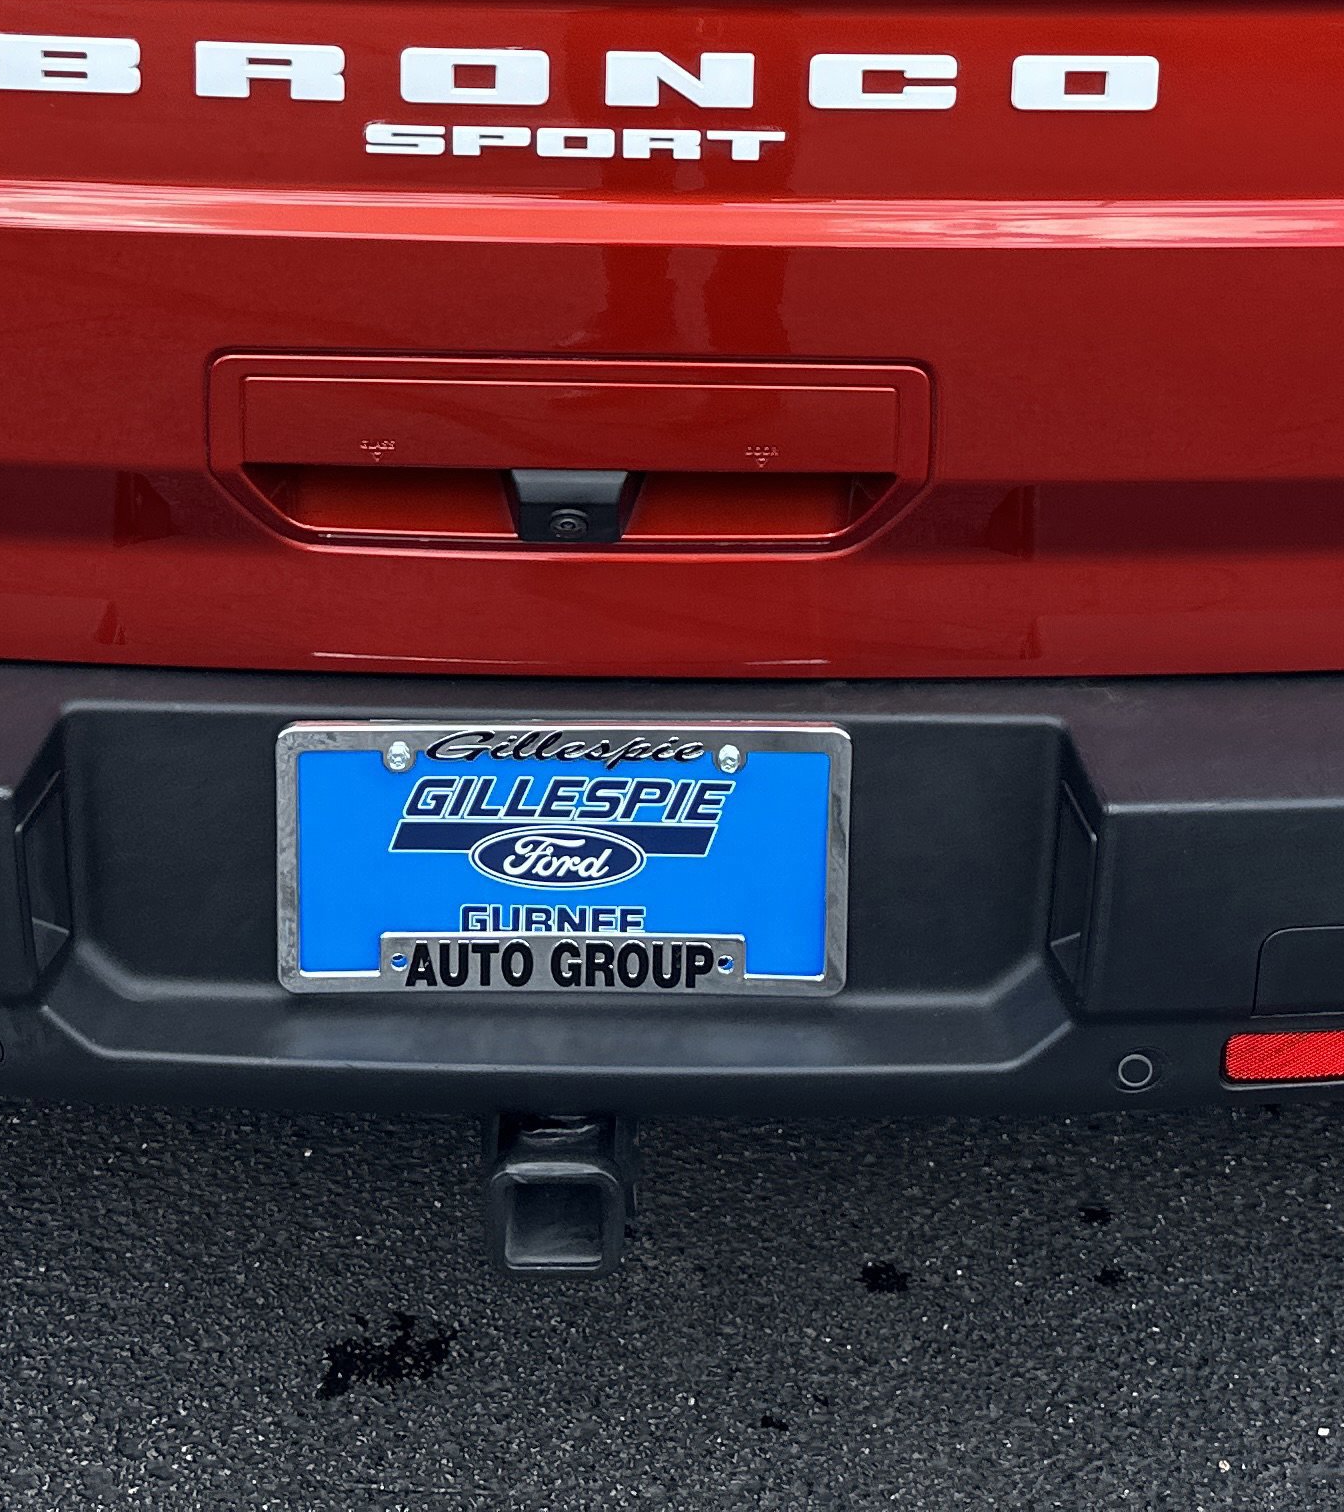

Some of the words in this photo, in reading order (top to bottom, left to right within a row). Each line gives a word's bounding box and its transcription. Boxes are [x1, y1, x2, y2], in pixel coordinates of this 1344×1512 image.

[364, 122, 785, 161] SPORT
[425, 729, 708, 770] Gillespie
[403, 775, 736, 824] GILLESPIE
[503, 835, 613, 878] Ford
[405, 939, 535, 987] AUTO
[550, 940, 715, 988] GROUP
